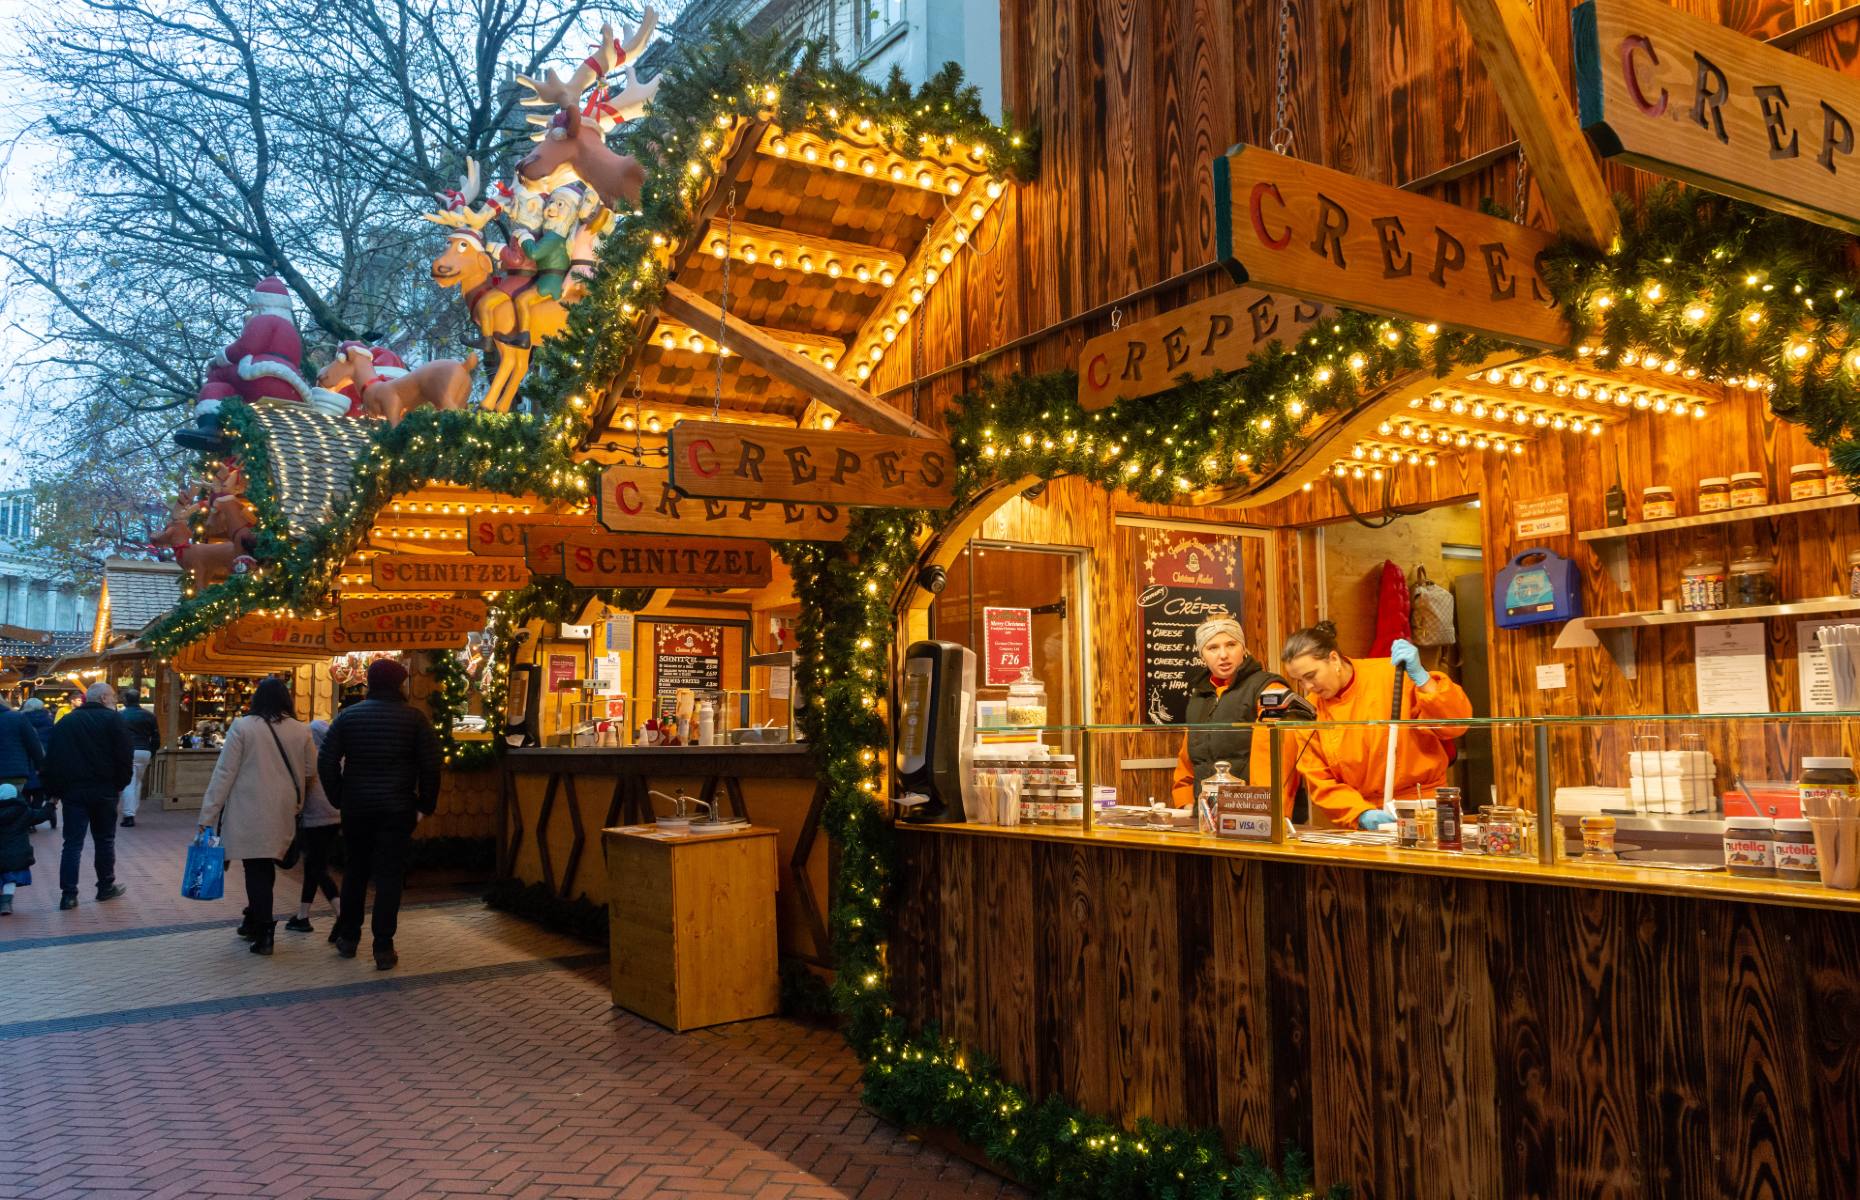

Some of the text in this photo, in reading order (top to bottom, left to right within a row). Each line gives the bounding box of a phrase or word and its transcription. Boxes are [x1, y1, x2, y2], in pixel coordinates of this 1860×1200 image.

[687, 438, 945, 489] CREPES
[575, 546, 762, 574] SCHNITZEL
[381, 562, 521, 583] SCHNITZEL
[1163, 596, 1229, 615] CRÊPES
[376, 615, 455, 630] CHIPS
[1152, 628, 1184, 637] CHEESE
[1153, 643, 1184, 651] CHEESE
[1000, 655, 1020, 665] F26
[1153, 658, 1185, 666] CHEESE
[1153, 671, 1185, 679] CHEESE
[1239, 821, 1255, 830] VISA
[1725, 841, 1766, 852] nutella
